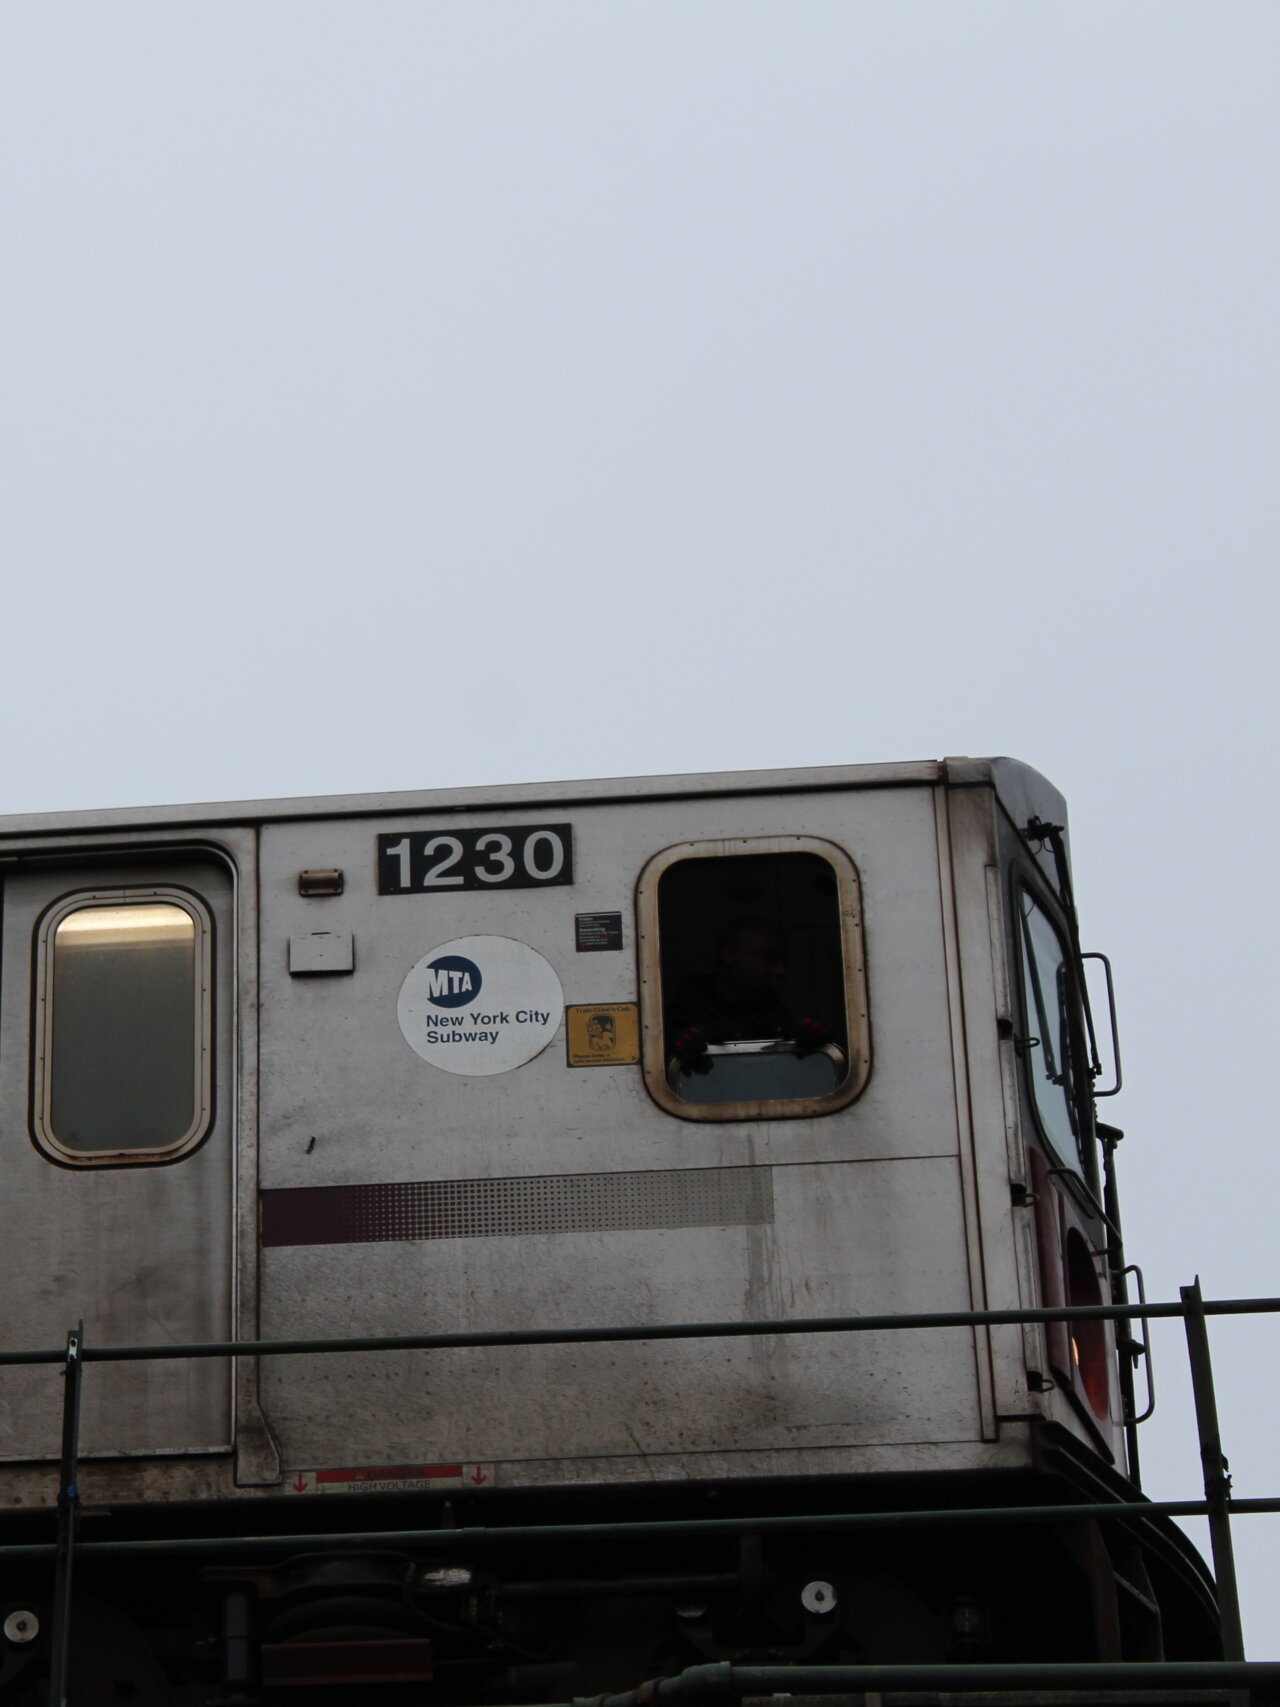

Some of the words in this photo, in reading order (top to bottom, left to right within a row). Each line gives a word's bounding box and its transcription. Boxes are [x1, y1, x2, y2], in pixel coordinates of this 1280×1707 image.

[386, 830, 564, 888] 1230
[425, 967, 473, 999] MTA
[426, 1014, 464, 1027] New
[470, 1012, 510, 1025] York
[515, 1010, 550, 1025] City
[426, 1030, 499, 1044] Subway
[367, 1469, 425, 1481] DANGER
[348, 1481, 377, 1492] HIGH
[380, 1480, 431, 1490] VOLTAGE
